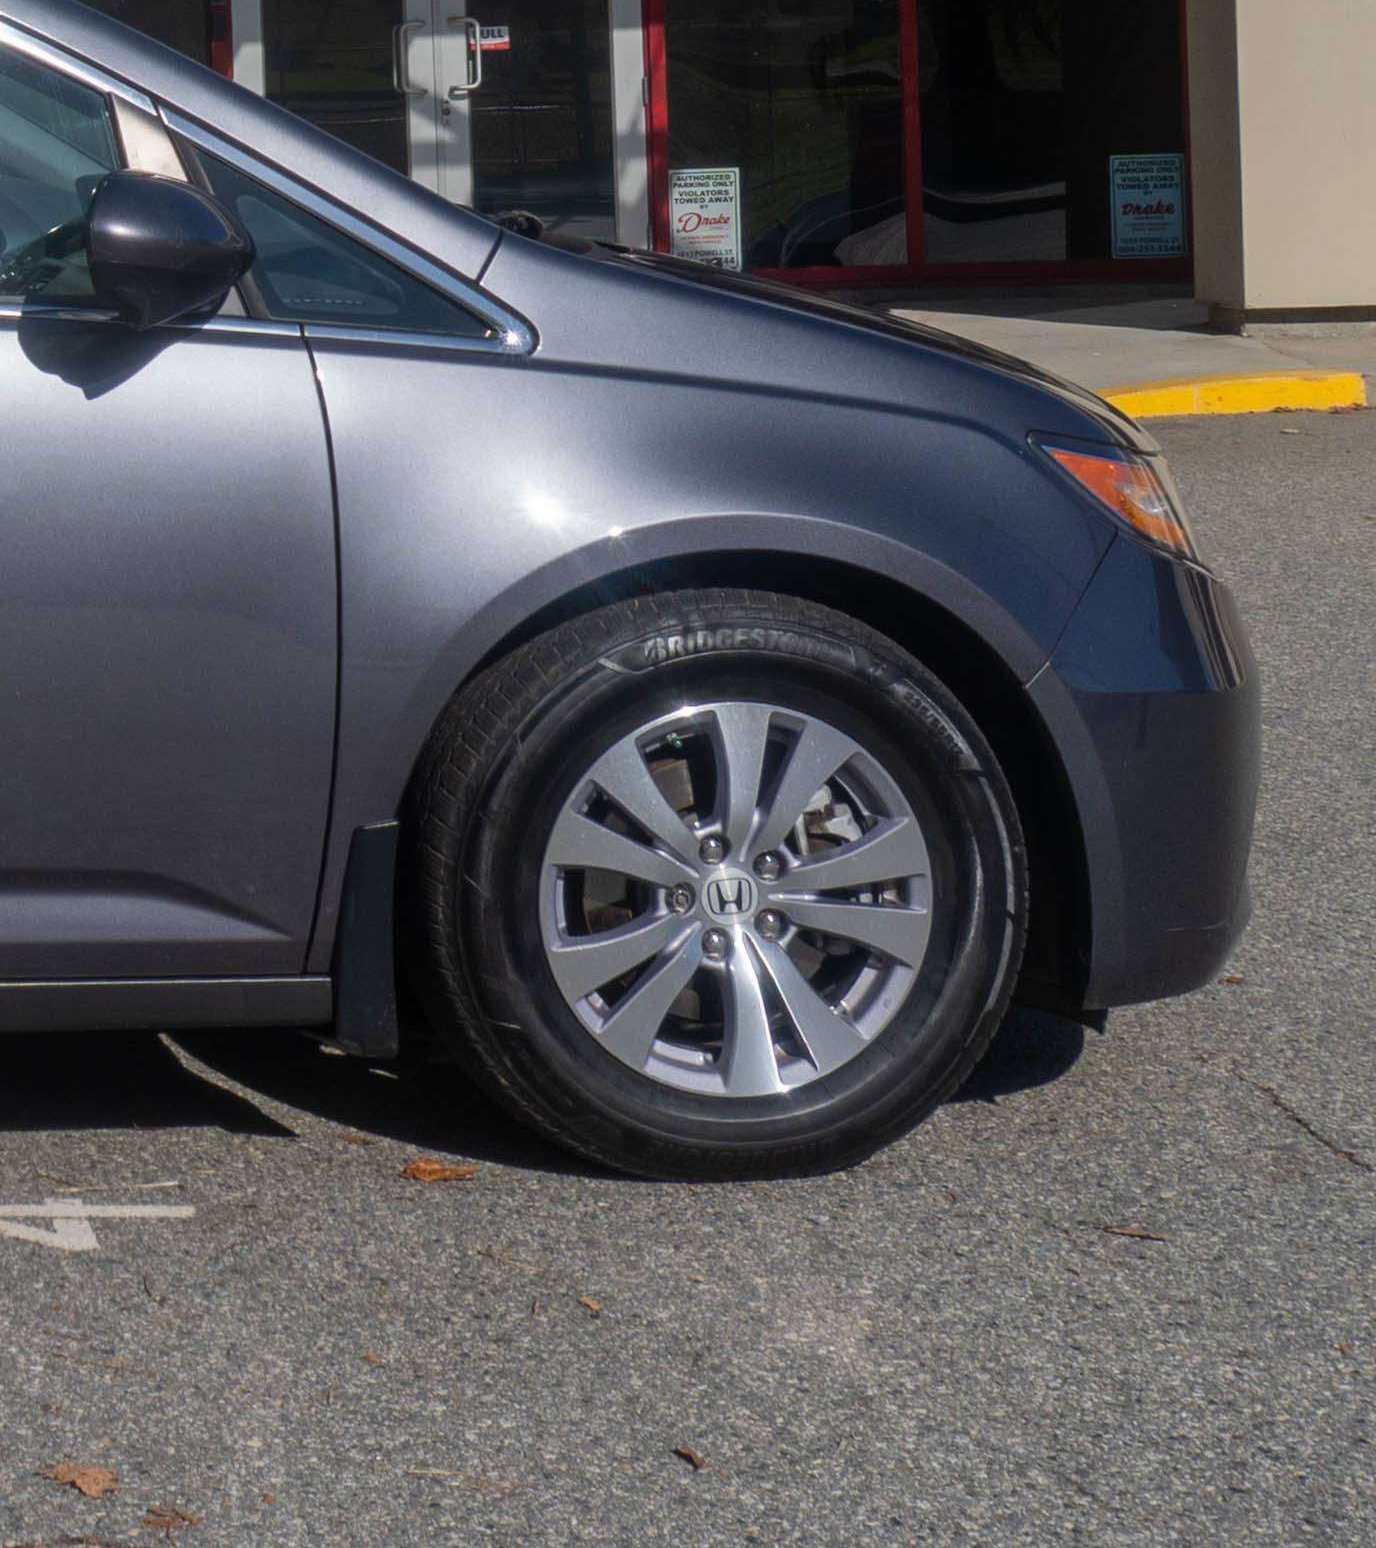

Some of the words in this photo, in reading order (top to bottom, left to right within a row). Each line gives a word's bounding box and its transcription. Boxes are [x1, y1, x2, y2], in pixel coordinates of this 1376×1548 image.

[678, 189, 730, 197] VIOLATORS
[1122, 198, 1175, 215] Drake
[676, 212, 731, 232] Drake
[644, 628, 845, 660] BRIDGESTONE
